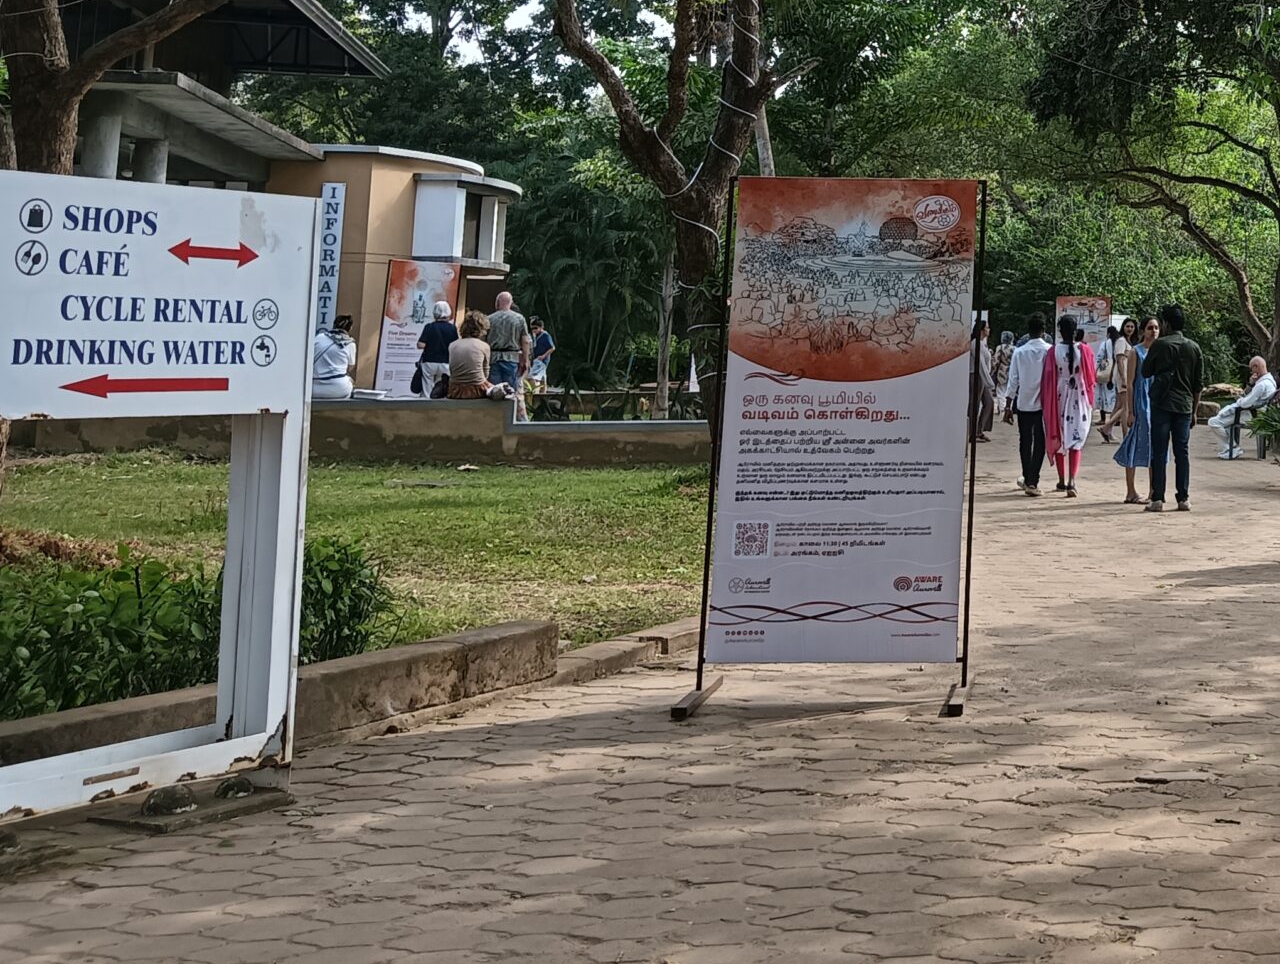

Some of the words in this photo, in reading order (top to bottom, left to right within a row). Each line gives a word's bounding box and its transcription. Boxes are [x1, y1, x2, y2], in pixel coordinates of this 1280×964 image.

[62, 204, 158, 236] SHOPS
[59, 244, 130, 277] CAFÉ
[60, 294, 146, 323] CYCLE
[153, 297, 249, 325] RENTAL
[11, 338, 155, 365] DRINKING
[163, 340, 247, 365] WATER
[742, 394, 769, 407] ஒரு
[773, 394, 814, 407] கனவு
[818, 391, 877, 407] பூமியில்
[741, 407, 799, 423] வடிவம்
[913, 575, 944, 583] AWARE
